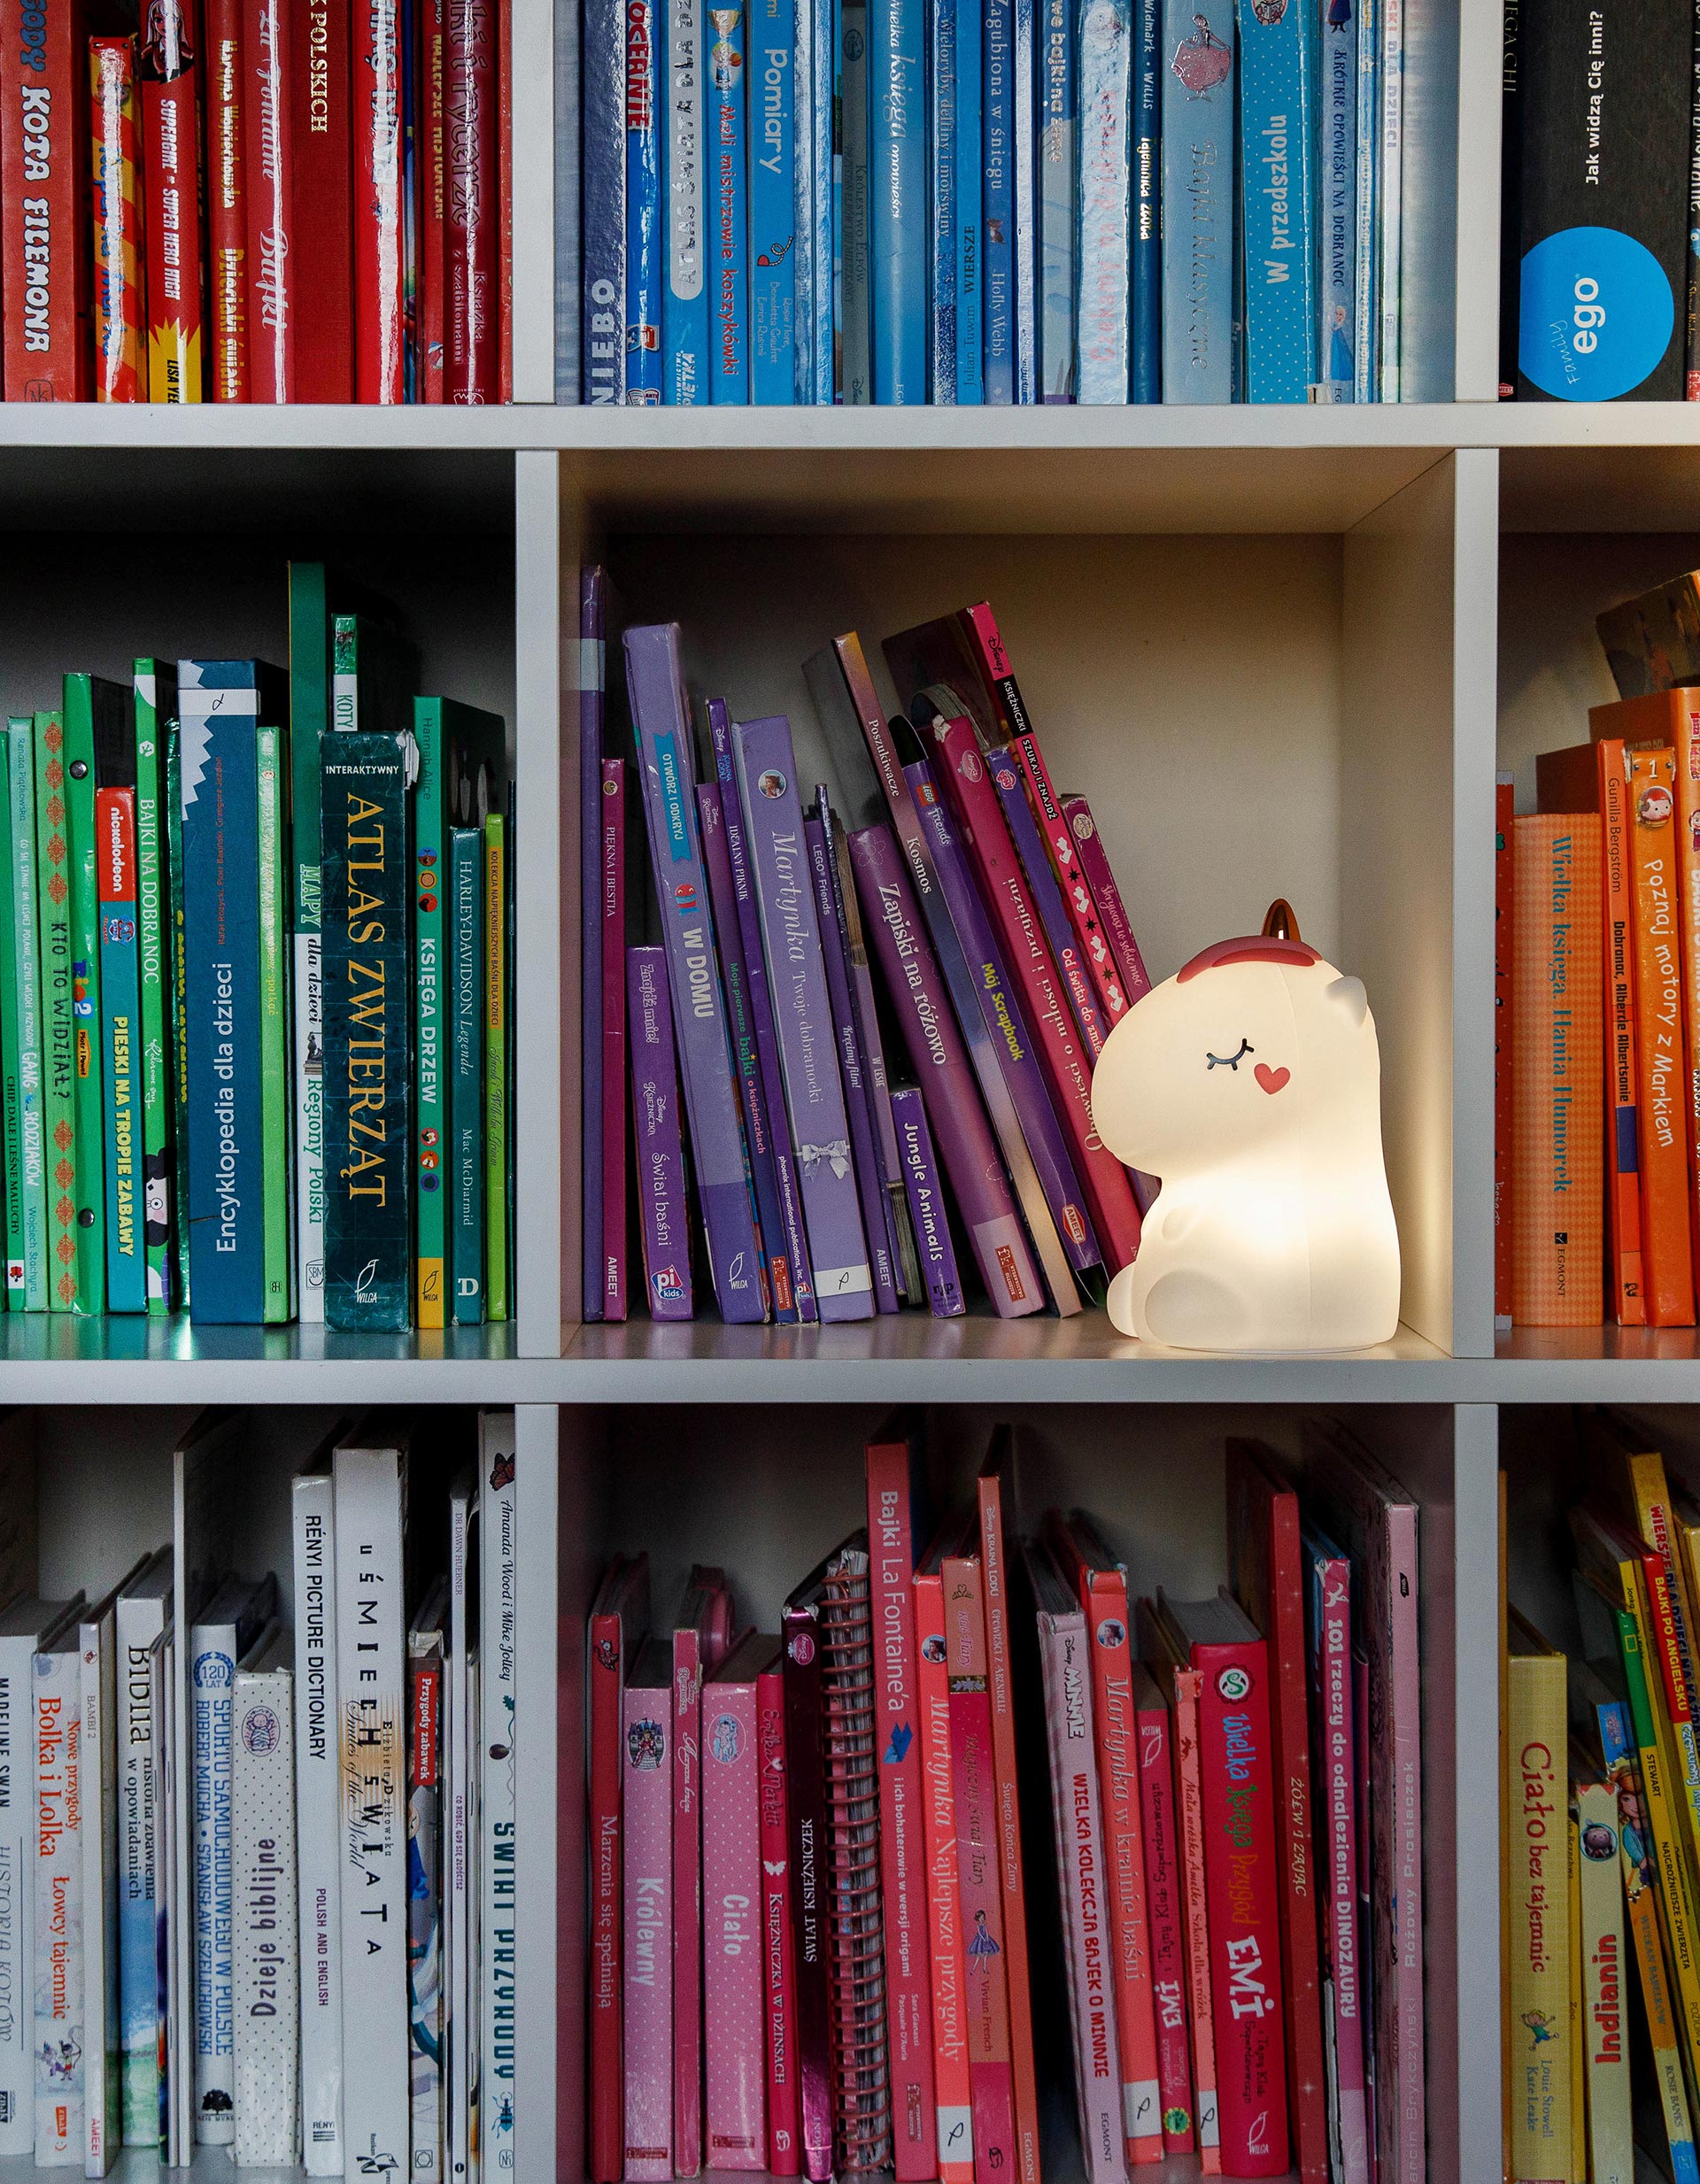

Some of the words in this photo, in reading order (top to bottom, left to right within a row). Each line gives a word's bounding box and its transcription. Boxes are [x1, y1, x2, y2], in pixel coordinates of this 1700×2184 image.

[1588, 12, 1604, 55] inni?
[310, 12, 327, 133] POLSKICH
[1048, 33, 1066, 83] bajki
[1332, 49, 1348, 107] KRÓTKIE
[1587, 61, 1605, 89] Cię
[759, 49, 788, 174] Pomiary
[1051, 88, 1062, 112] na
[1586, 94, 1605, 148] widzą
[160, 99, 177, 170] SUPERGIRL
[719, 104, 736, 147] Mali
[1332, 113, 1348, 183] OPOWIEŚCI
[1186, 139, 1218, 223] Bajki
[1261, 114, 1295, 250] przedszkolu
[1585, 154, 1600, 186] Jak
[162, 188, 179, 228] SUPER
[720, 155, 737, 259] mistrzowie
[1333, 190, 1346, 208] NA
[163, 231, 180, 264] HERO
[964, 225, 975, 294] WIERSZE
[1332, 215, 1346, 287] DOBRANOC
[164, 267, 180, 299] HIGH
[219, 248, 246, 333] Dzieciaki
[256, 228, 289, 329] Bajki
[1263, 259, 1289, 285] W
[718, 269, 739, 374] koszykówki
[1186, 235, 1217, 370] klasyczne
[1572, 277, 1607, 355] ego
[964, 305, 976, 352] Tuwim
[219, 337, 244, 398] świata
[964, 357, 976, 385] Julian
[18, 738, 28, 768] Renata
[325, 764, 399, 776] INTERAKTYWNY
[18, 771, 29, 821] Piątkowska
[662, 752, 677, 795] OTWÓRZ
[670, 802, 684, 840] ODKRYJ
[868, 718, 902, 798] Poszukiwacze
[906, 836, 933, 894] Kosmos
[1608, 777, 1620, 822] Gunilla
[138, 799, 154, 845] BAJKI
[730, 824, 744, 865] IDEALNY
[111, 806, 125, 891] nickelodeon
[141, 851, 155, 876] NA
[347, 791, 386, 943] ATLAS
[491, 850, 499, 887] KOLEKCJA
[1608, 827, 1624, 893] Bergström
[734, 867, 749, 901] PIKNIK
[771, 830, 809, 963] Martynka
[1643, 859, 1675, 935] Poznaj
[142, 881, 159, 984] DOBRANOC
[491, 889, 500, 958] NAJPIĘKNIEJSZYCH
[417, 938, 437, 1018] KSIĘGA
[491, 959, 501, 983] BAŚNI
[491, 984, 499, 999] DLA
[790, 970, 813, 1016] Twoje
[878, 882, 919, 959] Zapiski
[901, 961, 921, 990] na
[913, 992, 947, 1065] różowo
[1654, 944, 1681, 1026] motory
[212, 962, 235, 1036] dzieci
[491, 1001, 499, 1026] DZIECI
[981, 962, 1000, 988] Mój
[992, 991, 1024, 1061] Scrapbook
[214, 1043, 234, 1080] dla
[798, 1021, 823, 1104] dobranocki
[1658, 1033, 1671, 1046] z
[340, 959, 387, 1208] ZWIERZĄT
[421, 1027, 437, 1104] DRZEW
[1652, 1053, 1674, 1147] Markiem
[461, 1129, 473, 1152] Mac
[214, 1086, 240, 1252] Encyklopedia
[461, 1159, 475, 1225] McDiarmid
[651, 1152, 671, 1196] Świat
[777, 1155, 789, 1183] phoenix
[784, 1184, 796, 1226] international
[903, 1123, 926, 1181] Jungle
[917, 1188, 945, 1262] Animals
[27, 1207, 38, 1249] Wojciech
[654, 1202, 672, 1246] baśni
[789, 1227, 803, 1269] publications,
[877, 1248, 891, 1288] AMEET
[27, 1251, 40, 1292] Stachyra
[607, 1256, 618, 1298] AMEET
[663, 1289, 680, 1298] kids
[730, 1280, 748, 1290] WILGA
[794, 1269, 804, 1282] inc.
[1557, 1248, 1565, 1297] EGMONT
[355, 1292, 379, 1304] WILGA
[305, 1515, 328, 1568] RÉNYI
[455, 1512, 465, 1525] DR
[455, 1526, 466, 1553] DAWN
[499, 1500, 514, 1555] Amanda
[877, 1491, 901, 1547] Bajki
[985, 1506, 997, 1532] Disney
[882, 1558, 904, 1584] La
[986, 1532, 999, 1566] KRAINA
[455, 1555, 467, 1596] HUEBNER
[499, 1559, 514, 1598] Wood
[987, 1569, 1000, 1596] LODU
[306, 1575, 327, 1648] PICTURE
[501, 1611, 515, 1642] Mike
[884, 1592, 909, 1711] Fontaine'a
[1327, 1619, 1345, 1654] 101
[205, 1679, 222, 1688] LAT
[498, 1643, 514, 1682] Jolley
[307, 1655, 328, 1760] DICTIONARY
[1330, 1657, 1346, 1725] rzeczy
[925, 1694, 952, 1827] Martynka
[1333, 1733, 1348, 1757] do
[1183, 1778, 1198, 1816] Mała
[1518, 1741, 1556, 1839] Ciało
[1646, 1754, 1662, 1798] STEWART
[382, 1783, 395, 1857] Dzikowska
[1001, 1782, 1015, 1820] Święto
[1003, 1822, 1016, 1860] Końca
[1185, 1817, 1199, 1858] wróżka
[1332, 1763, 1352, 1895] odnalezienia
[599, 1815, 618, 1897] Marzenia
[1004, 1862, 1019, 1892] Zimy
[1528, 1845, 1550, 1879] bez
[50, 1877, 70, 1934] Łowcy
[249, 1839, 285, 1929] biblijne
[931, 1837, 957, 1946] Najlepsze
[1186, 1861, 1202, 1906] Amelka
[315, 1887, 327, 1928] POLISH
[598, 1902, 614, 1927] się
[722, 1894, 751, 1955] Ciało
[1523, 1885, 1552, 1972] tajemnic
[316, 1933, 328, 1955] AND
[630, 1877, 666, 1986] Królewny
[1191, 1913, 1205, 1951] Szkoła
[50, 1941, 70, 2020] tajemnic
[249, 1943, 281, 2018] Dzieje
[595, 1933, 619, 2009] spełniają
[1194, 1954, 1206, 1974] dla
[1336, 1900, 1356, 2018] DINOZAURY
[317, 1960, 329, 2007] ENGLISH
[980, 1979, 991, 2012] Vivian
[1192, 1977, 1208, 2020] wróżek
[1591, 1934, 1620, 2064] Indianin
[932, 1954, 965, 2061] przygody
[983, 2016, 993, 2052] French
[1664, 2064, 1679, 2094] ROSIE
[1669, 2095, 1684, 2127] BANKS
[91, 2118, 100, 2157] AMEET
[1023, 2132, 1035, 2183] EGMONT
[1101, 2111, 1112, 2163] EGMONT
